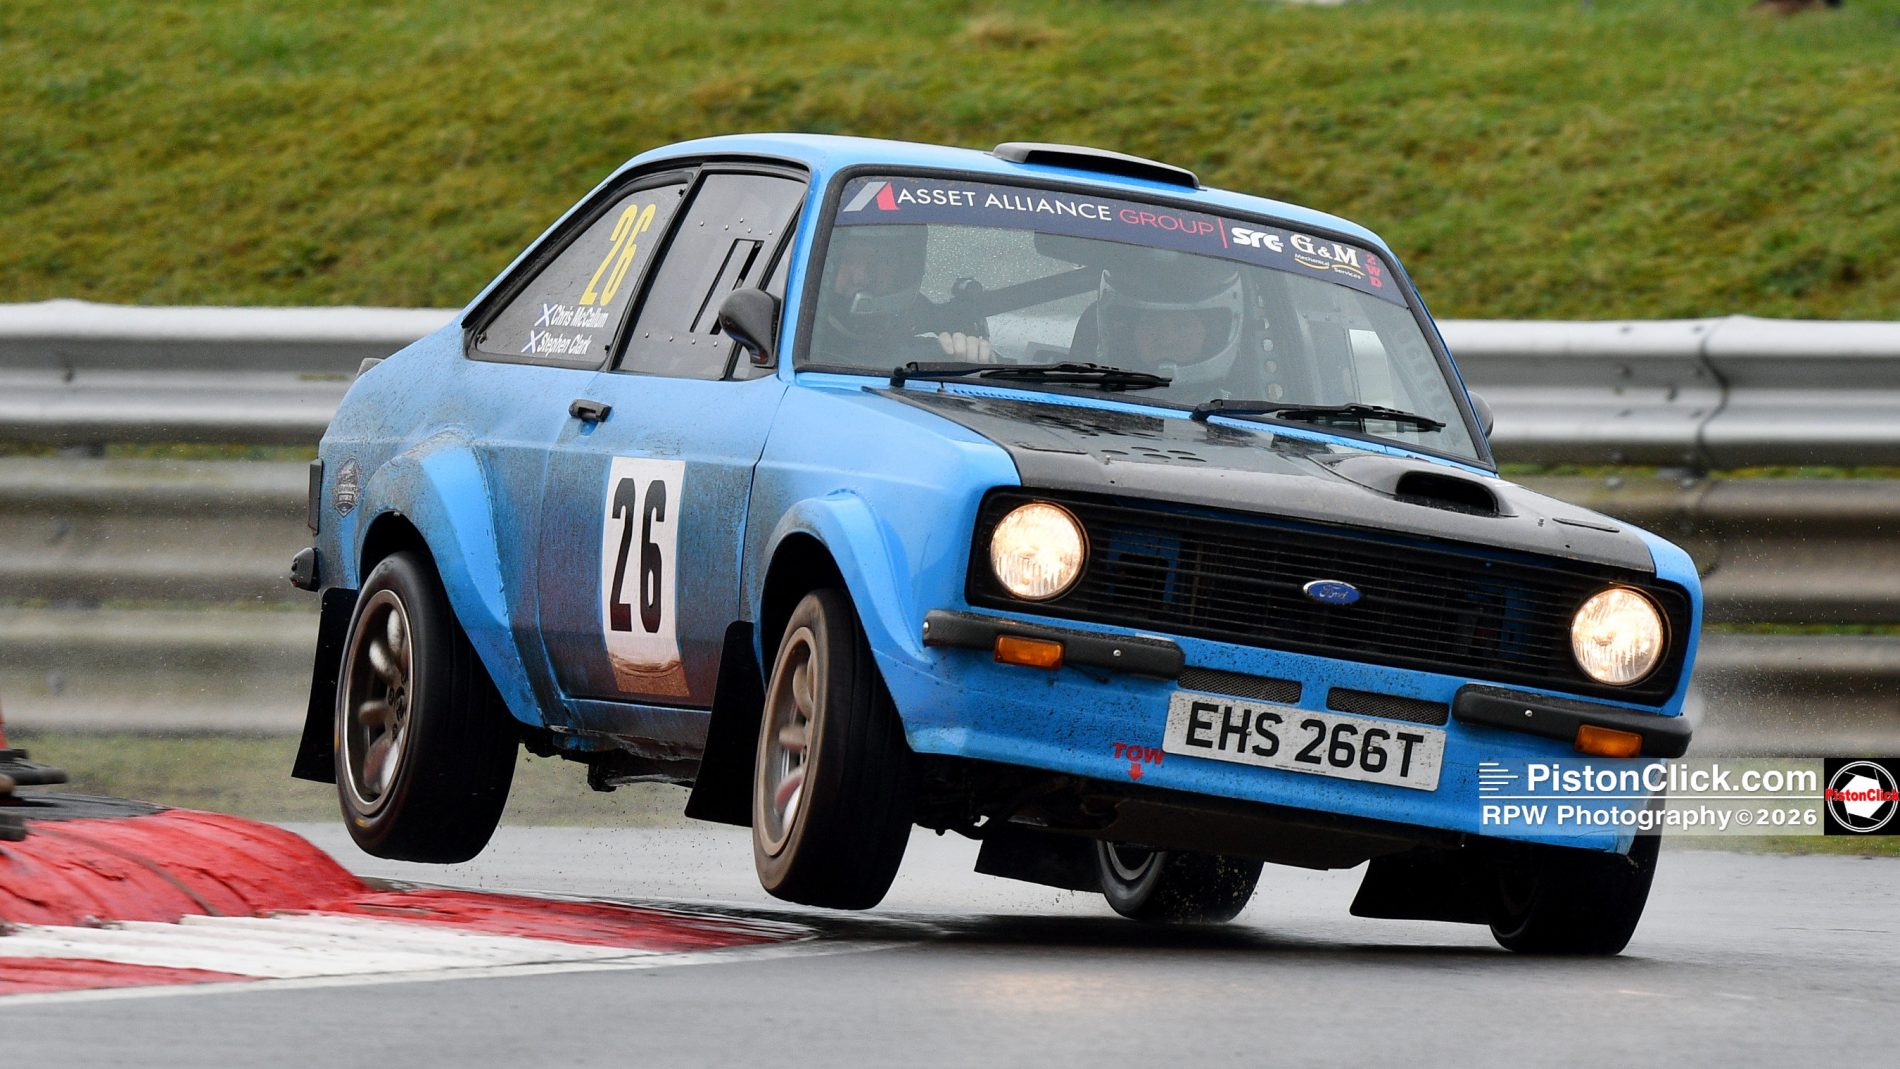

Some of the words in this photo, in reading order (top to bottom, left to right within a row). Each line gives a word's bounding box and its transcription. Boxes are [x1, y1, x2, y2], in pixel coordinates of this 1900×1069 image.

[897, 188, 976, 208] ASSET
[984, 193, 1112, 222] ALLIANCE
[1119, 208, 1215, 236] GROUP
[578, 203, 657, 306] 26
[1290, 234, 1361, 268] G&M
[1294, 253, 1330, 267] Mechanical
[1333, 267, 1362, 280] Services
[550, 304, 575, 327] Chris
[537, 332, 572, 357] Stephen
[568, 333, 593, 355] Clark
[609, 477, 667, 634] 26
[1319, 584, 1349, 600] Ford
[1185, 700, 1284, 758] EHS
[1294, 718, 1425, 778] 266T
[1112, 742, 1165, 766] TOW
